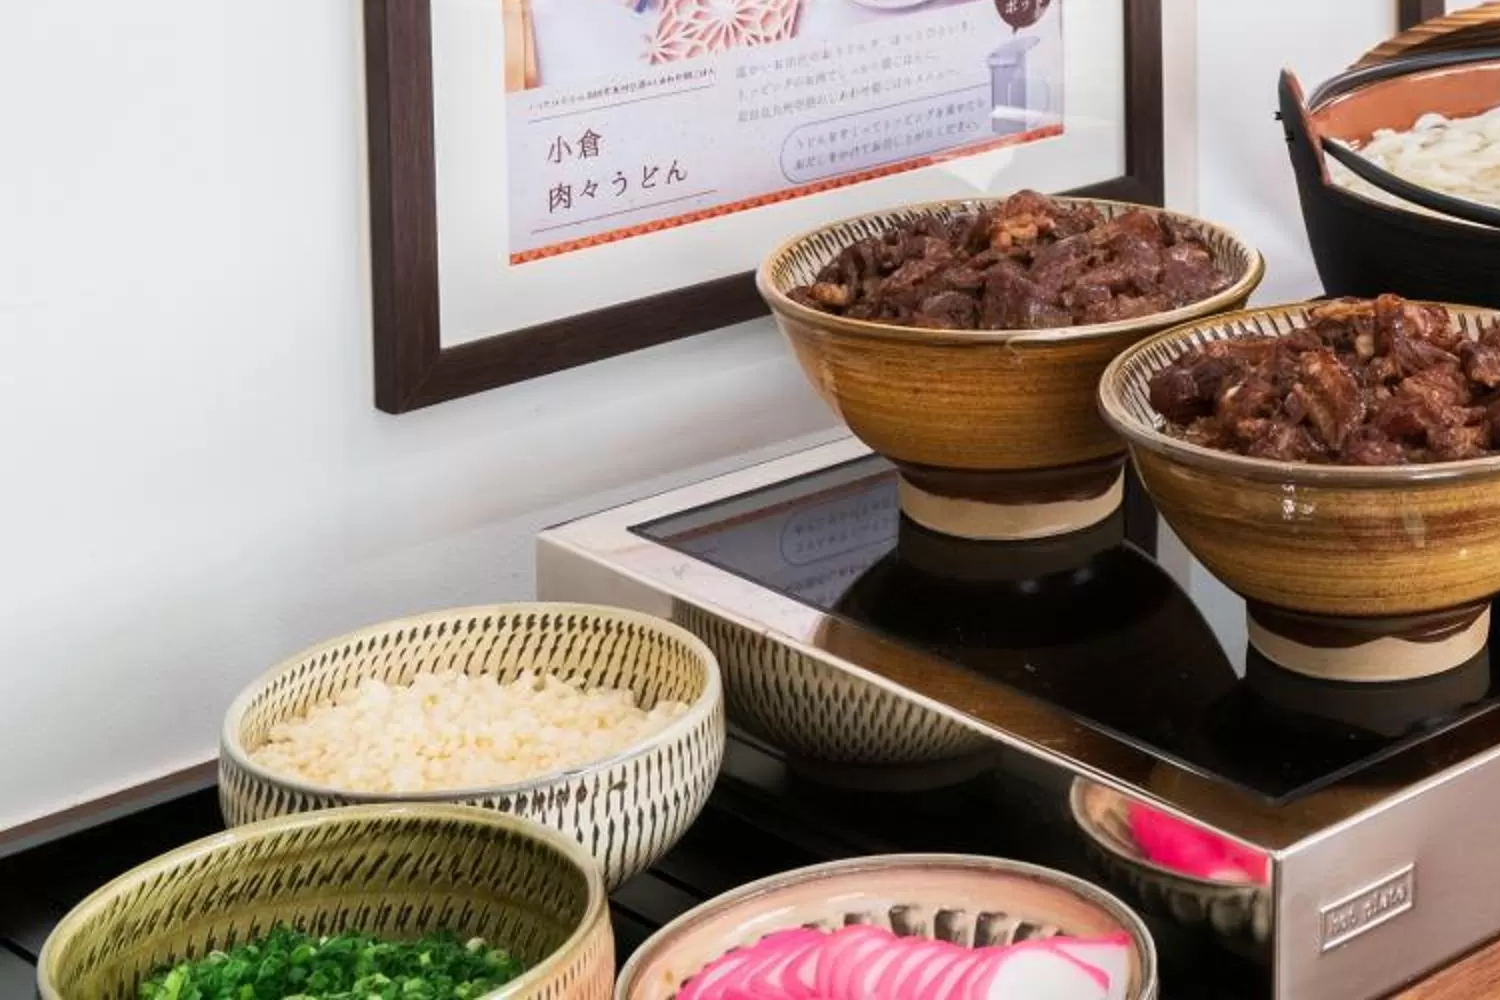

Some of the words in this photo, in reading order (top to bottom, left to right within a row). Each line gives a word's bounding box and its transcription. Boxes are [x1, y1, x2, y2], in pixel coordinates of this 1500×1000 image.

[547, 128, 602, 164] 小倉
[549, 160, 688, 213] 肉々うどん
